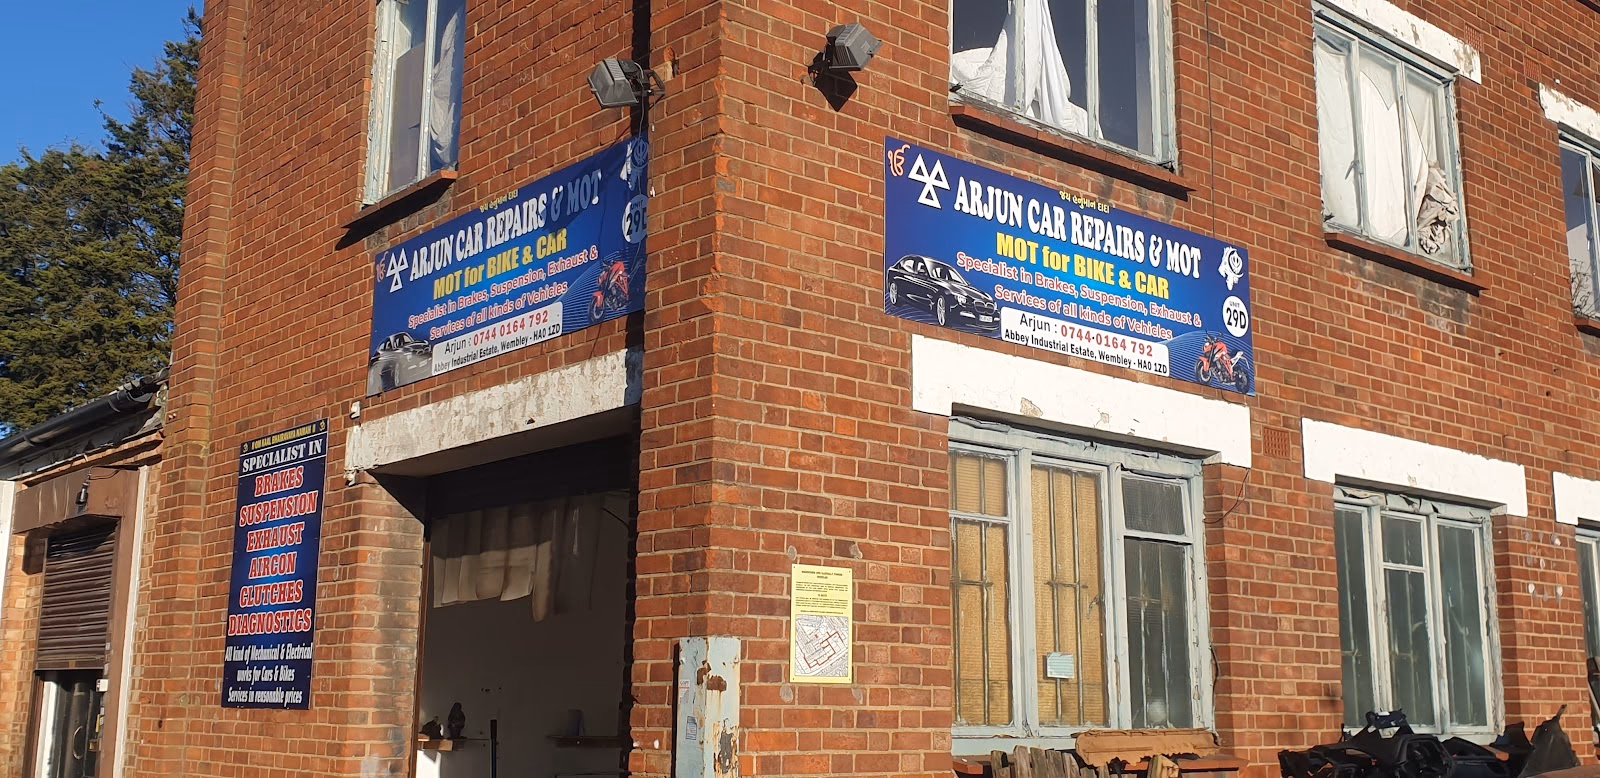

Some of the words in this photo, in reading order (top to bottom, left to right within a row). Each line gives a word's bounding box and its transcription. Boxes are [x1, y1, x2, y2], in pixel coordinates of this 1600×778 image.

[410, 235, 454, 281] ARJUN
[456, 222, 483, 262] CAR
[486, 193, 547, 249] REPAIRS
[551, 185, 564, 221] &
[567, 171, 602, 216] MOT
[954, 176, 1023, 229] ARJUN
[1027, 198, 1067, 242] CAR
[1070, 211, 1145, 264] REPAIRS
[1149, 235, 1163, 268] &
[1166, 239, 1201, 279] MOT
[434, 270, 462, 299] MOT
[464, 264, 485, 288] for
[487, 247, 520, 279] BIKE
[522, 246, 533, 265] &
[536, 228, 568, 261] CAR
[996, 231, 1039, 265] MOT
[1042, 245, 1070, 273] for
[1074, 253, 1115, 286] BIKE
[1118, 269, 1132, 290] &
[1135, 271, 1170, 300] CAR
[408, 299, 447, 329] Specialist
[447, 299, 456, 312] in
[458, 289, 489, 309] Brakes,
[490, 268, 546, 297] Suspension,
[548, 251, 589, 276] Exhaust
[589, 244, 599, 261] &
[956, 251, 1018, 281] Specialist
[1021, 267, 1033, 284] in
[1035, 271, 1079, 298] Brakes,
[1080, 285, 1148, 316] Suspension,
[1149, 303, 1192, 325] Exhaust
[1193, 313, 1202, 327] &
[430, 319, 465, 341] Services
[466, 313, 476, 328] of
[476, 309, 487, 324] all
[489, 301, 514, 319] kinds
[515, 294, 526, 309] of
[527, 281, 568, 306] Vehicles
[444, 338, 467, 355] Arjun
[473, 330, 497, 347] 0744
[499, 318, 525, 337] 0164
[528, 309, 549, 328] 792
[994, 284, 1046, 310] Services
[1048, 300, 1062, 313] of
[1063, 303, 1077, 319] all
[1080, 306, 1111, 326] kinds
[1113, 313, 1127, 329] of
[1127, 318, 1173, 340] Vehicles
[1226, 307, 1246, 329] 29D
[434, 359, 450, 374] Abbey
[451, 349, 479, 368] Industrial
[479, 344, 500, 359] Estate,
[501, 335, 529, 351] Wembley
[548, 323, 561, 335] 1ZD
[1005, 328, 1029, 346] Abbey
[1031, 335, 1068, 352] Industrial
[1071, 342, 1097, 361] Estate,
[1098, 350, 1132, 369] Wembley
[1154, 363, 1167, 374] 1ZD
[1019, 313, 1050, 333] Arjun
[1131, 341, 1153, 357] 792
[242, 443, 306, 472] SPECIALIST
[308, 439, 323, 456] IN
[254, 465, 304, 497] BRAKES
[239, 490, 319, 527] SUSPENSION
[246, 521, 305, 552] EXHAUST
[248, 551, 297, 579] AIRCON
[239, 579, 303, 608] CLUTCHES
[228, 608, 312, 636] DIAGNOSTICS
[225, 646, 233, 661] All
[233, 646, 244, 661] kind
[244, 645, 251, 665] of
[250, 644, 280, 660] Mechanical
[280, 644, 285, 660] &
[285, 642, 313, 660] Electrical
[237, 666, 252, 682] works
[251, 666, 261, 686] for
[261, 665, 273, 682] Cars
[274, 665, 279, 682] &
[279, 665, 295, 682] Bikes
[228, 686, 248, 702] Services
[248, 686, 255, 702] in
[255, 686, 284, 703] reasonable
[284, 686, 303, 707] prices
